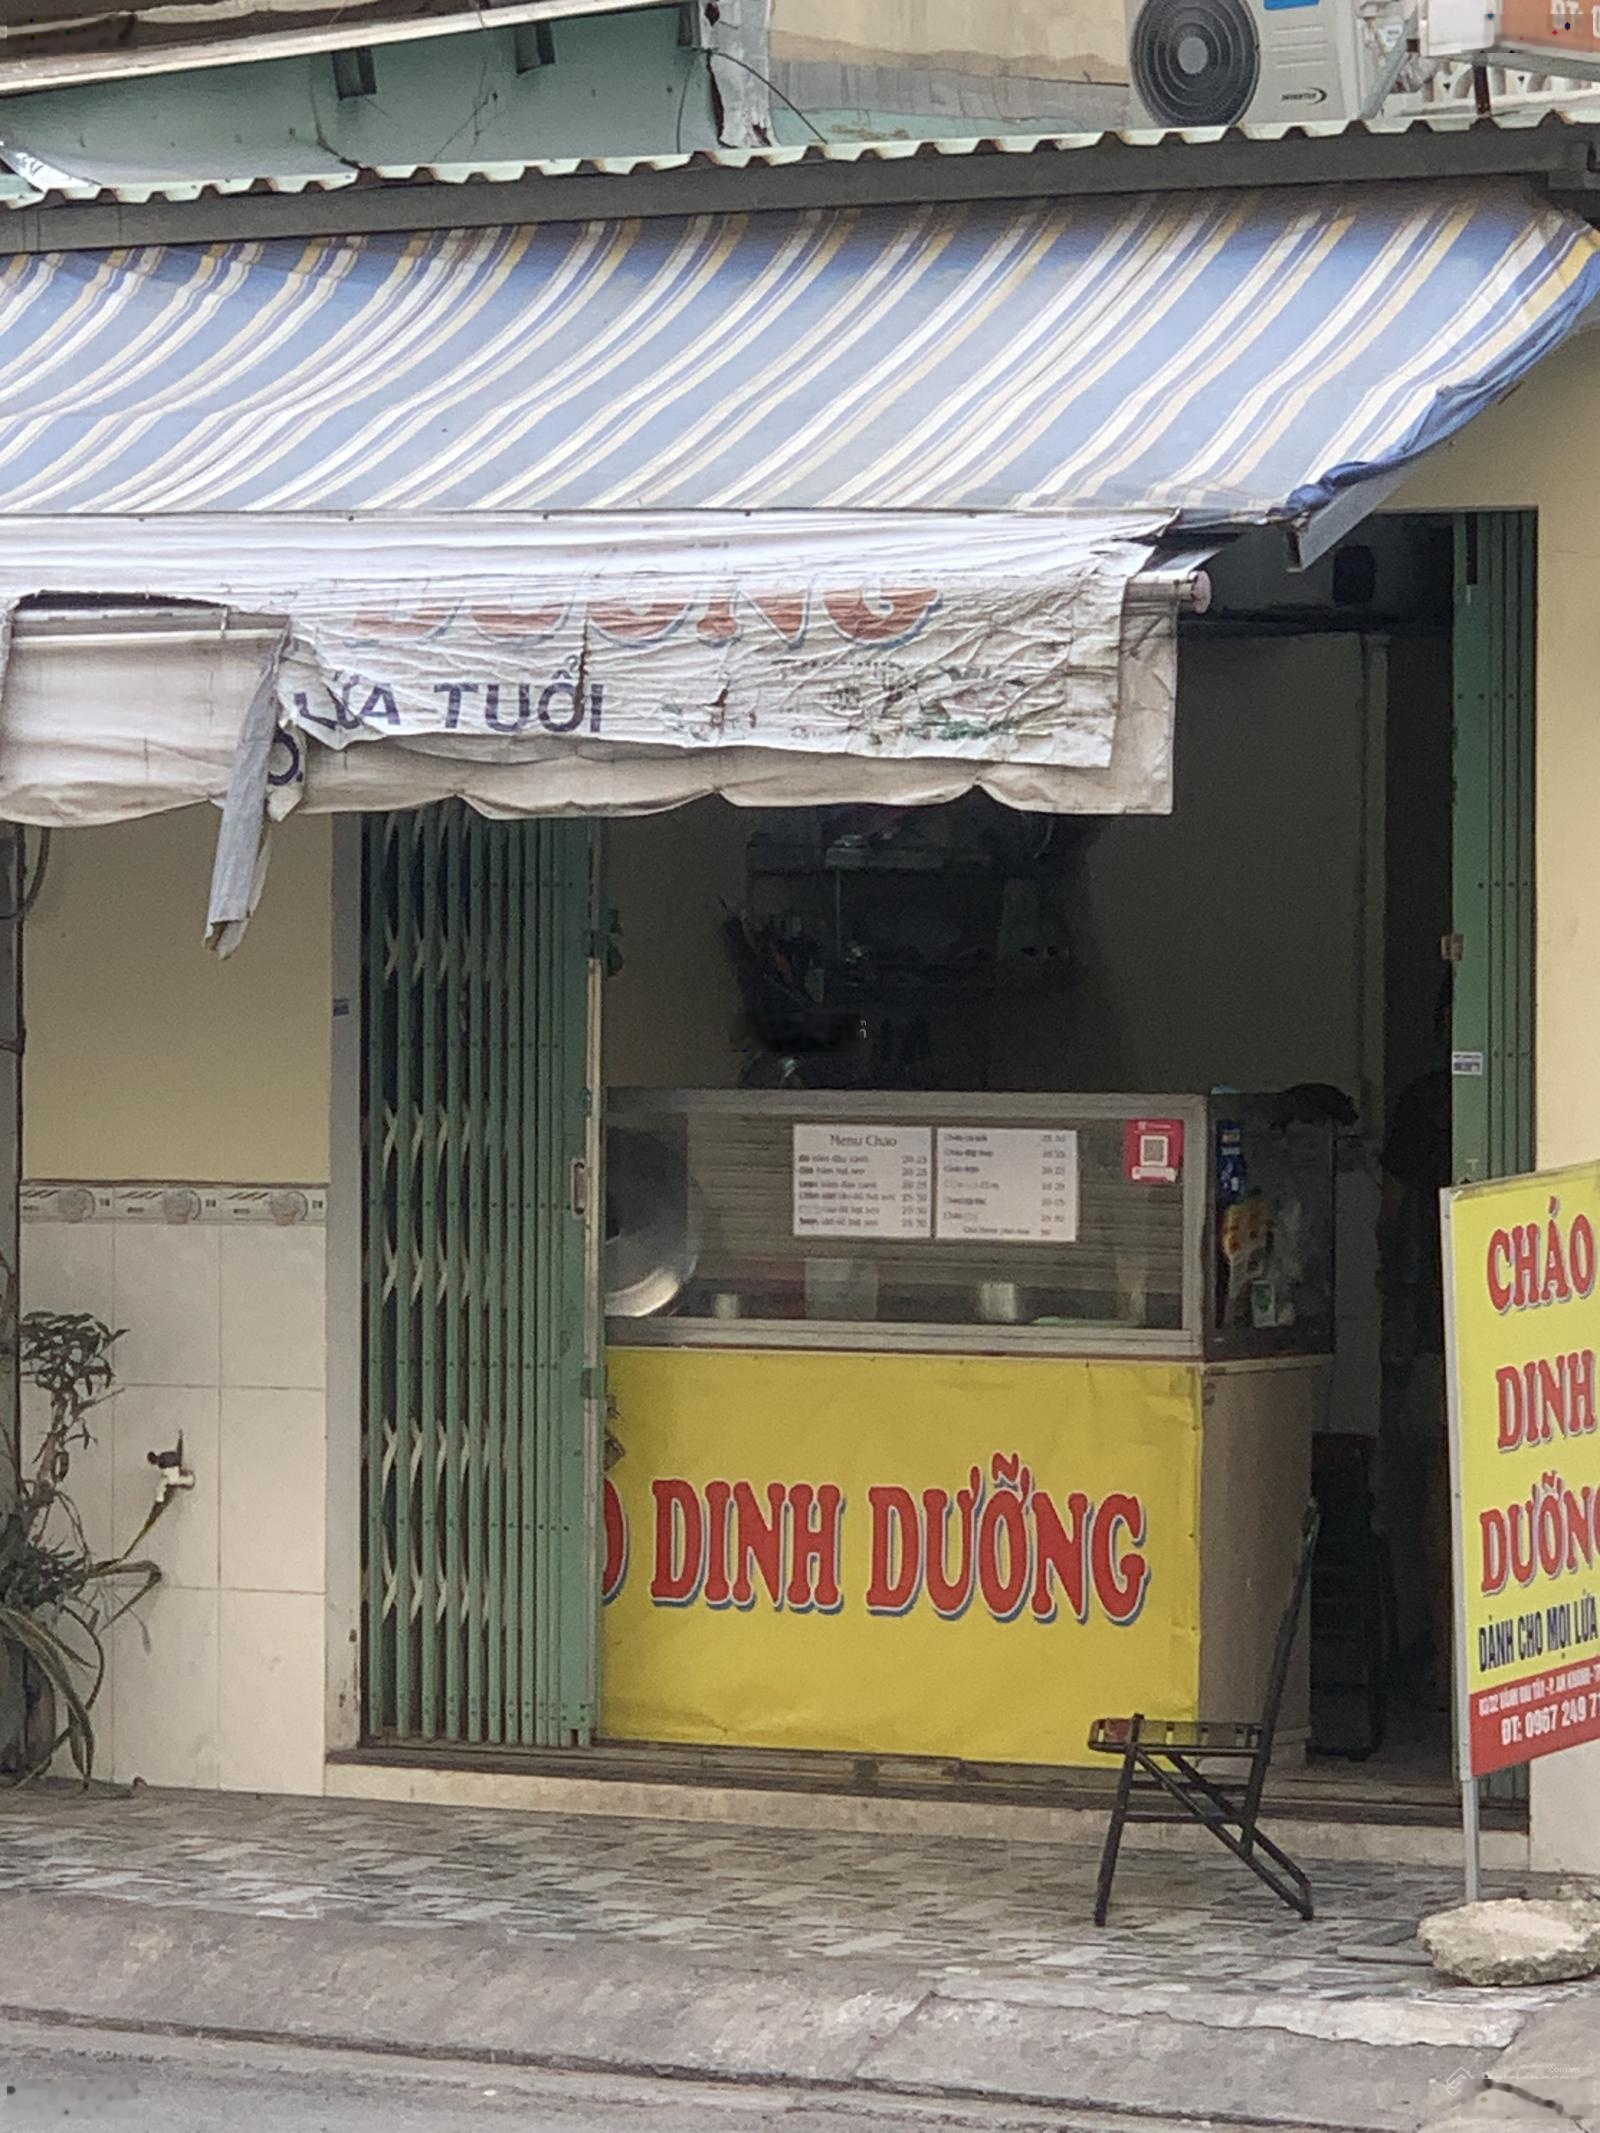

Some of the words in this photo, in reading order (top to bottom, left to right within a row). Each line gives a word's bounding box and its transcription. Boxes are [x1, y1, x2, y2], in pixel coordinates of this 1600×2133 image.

[434, 654, 605, 733] TUỔI
[1487, 1195, 1596, 1315] CHÁO
[1495, 1349, 1597, 1454] DINH
[650, 1478, 845, 1611] DINH
[866, 1451, 1148, 1626] DƯỠNG
[1480, 1470, 1600, 1597] DƯỠN
[1478, 1614, 1514, 1672] DÀNH
[1518, 1611, 1543, 1660] CHO
[1547, 1603, 1571, 1659] MỌI
[1574, 1588, 1598, 1644] LỨA
[1525, 1703, 1558, 1738] 0967
[1561, 1696, 1587, 1728] 249
[1589, 1692, 1600, 1718] 7
